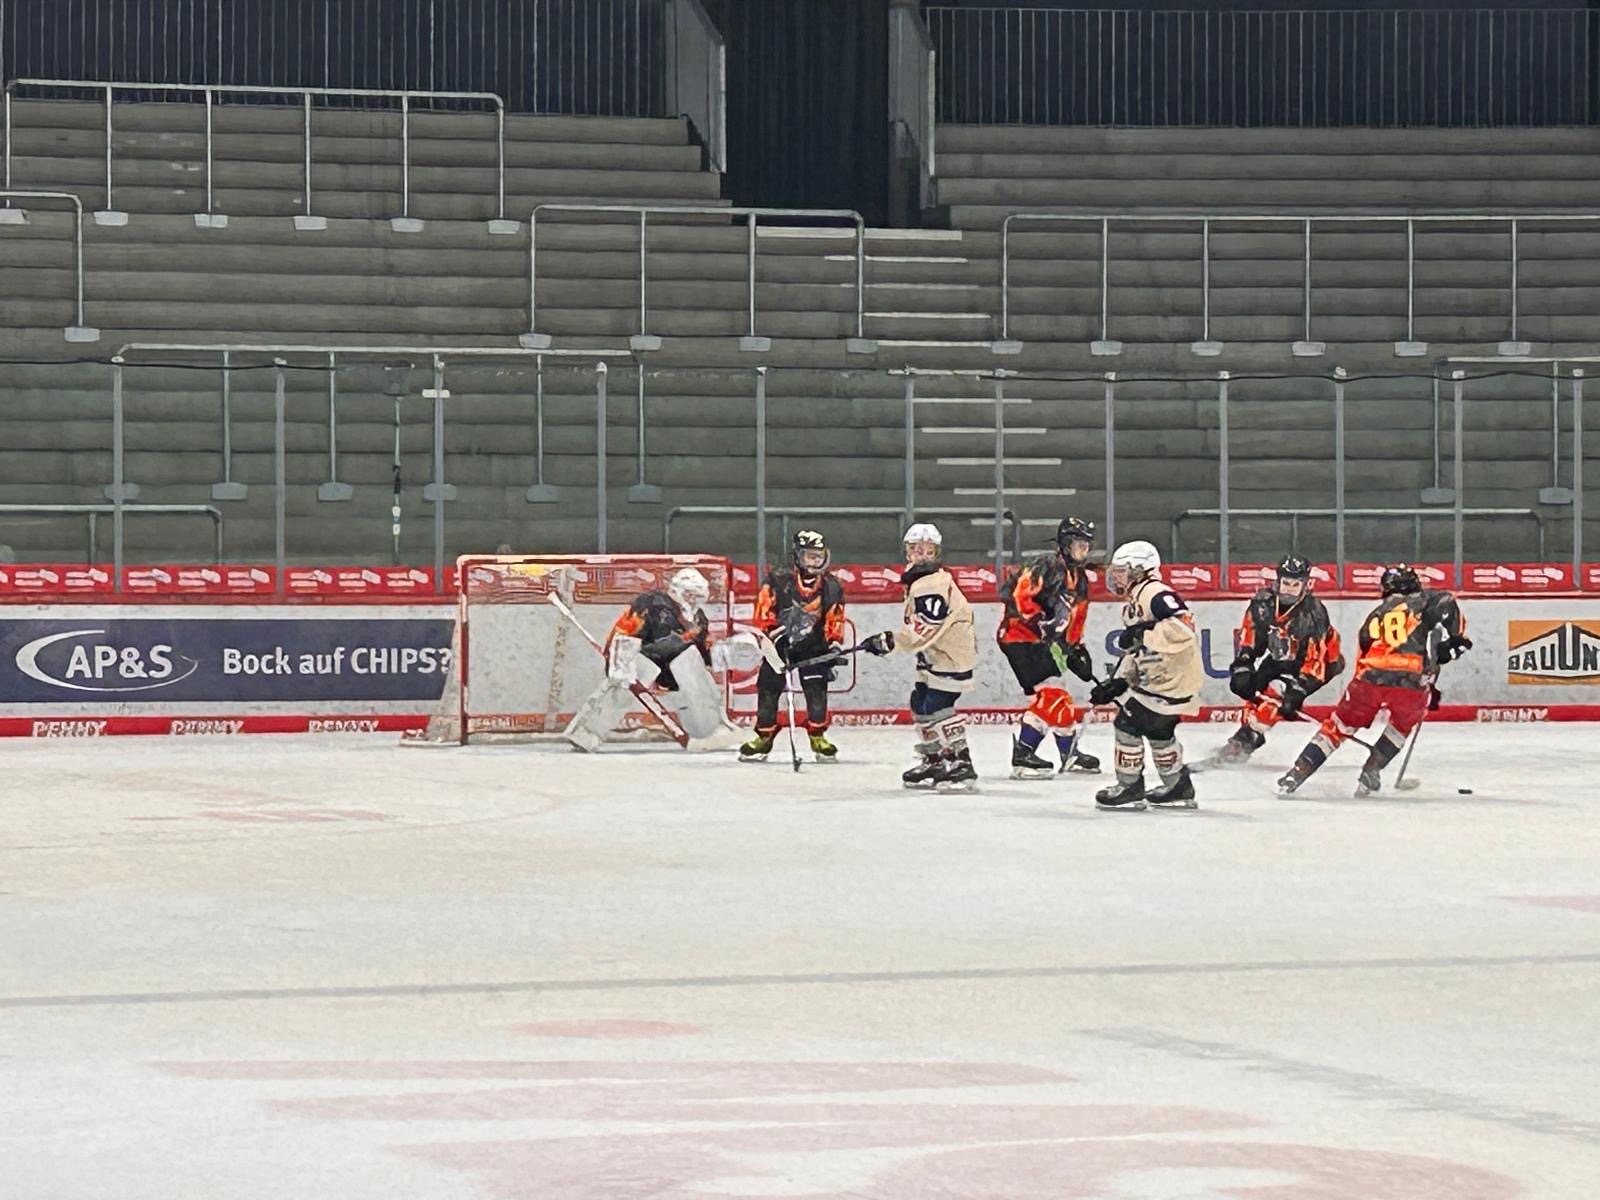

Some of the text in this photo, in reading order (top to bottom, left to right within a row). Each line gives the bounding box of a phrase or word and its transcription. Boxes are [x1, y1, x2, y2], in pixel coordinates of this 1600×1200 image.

[65, 644, 173, 679] AP&S
[223, 646, 451, 675] Bock auf CHIPS?
[1508, 621, 1600, 671] BAUUN
